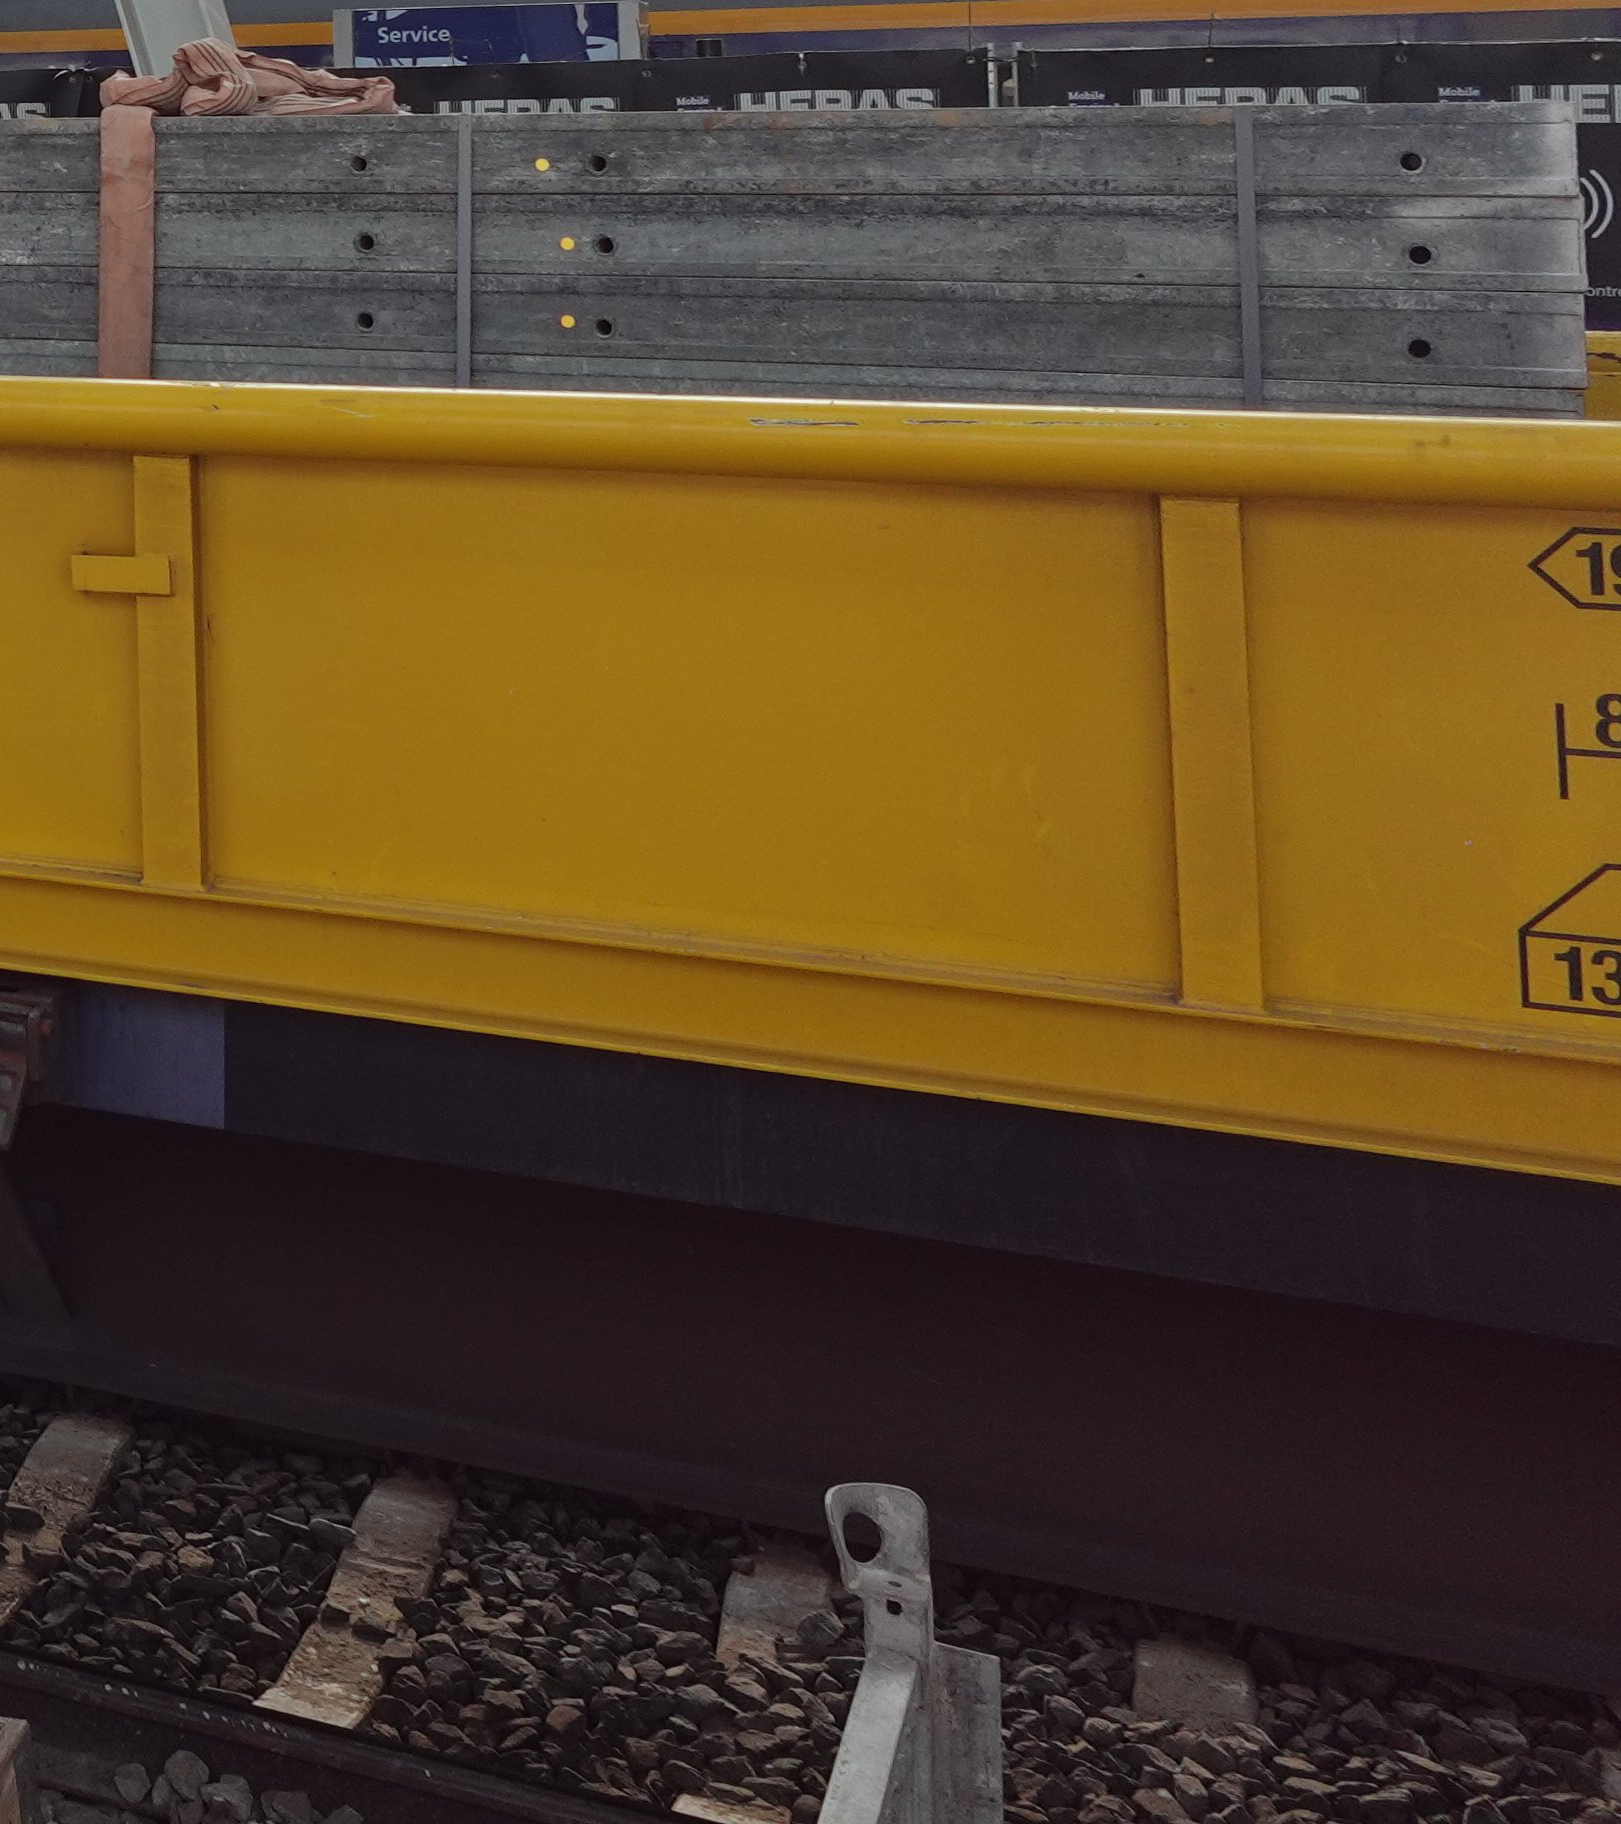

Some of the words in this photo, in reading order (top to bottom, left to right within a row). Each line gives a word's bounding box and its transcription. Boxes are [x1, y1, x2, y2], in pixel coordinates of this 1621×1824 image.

[377, 26, 451, 44] Service
[1068, 91, 1105, 101] Mobile
[1438, 86, 1480, 97] Mobile
[676, 96, 710, 106] Mobile
